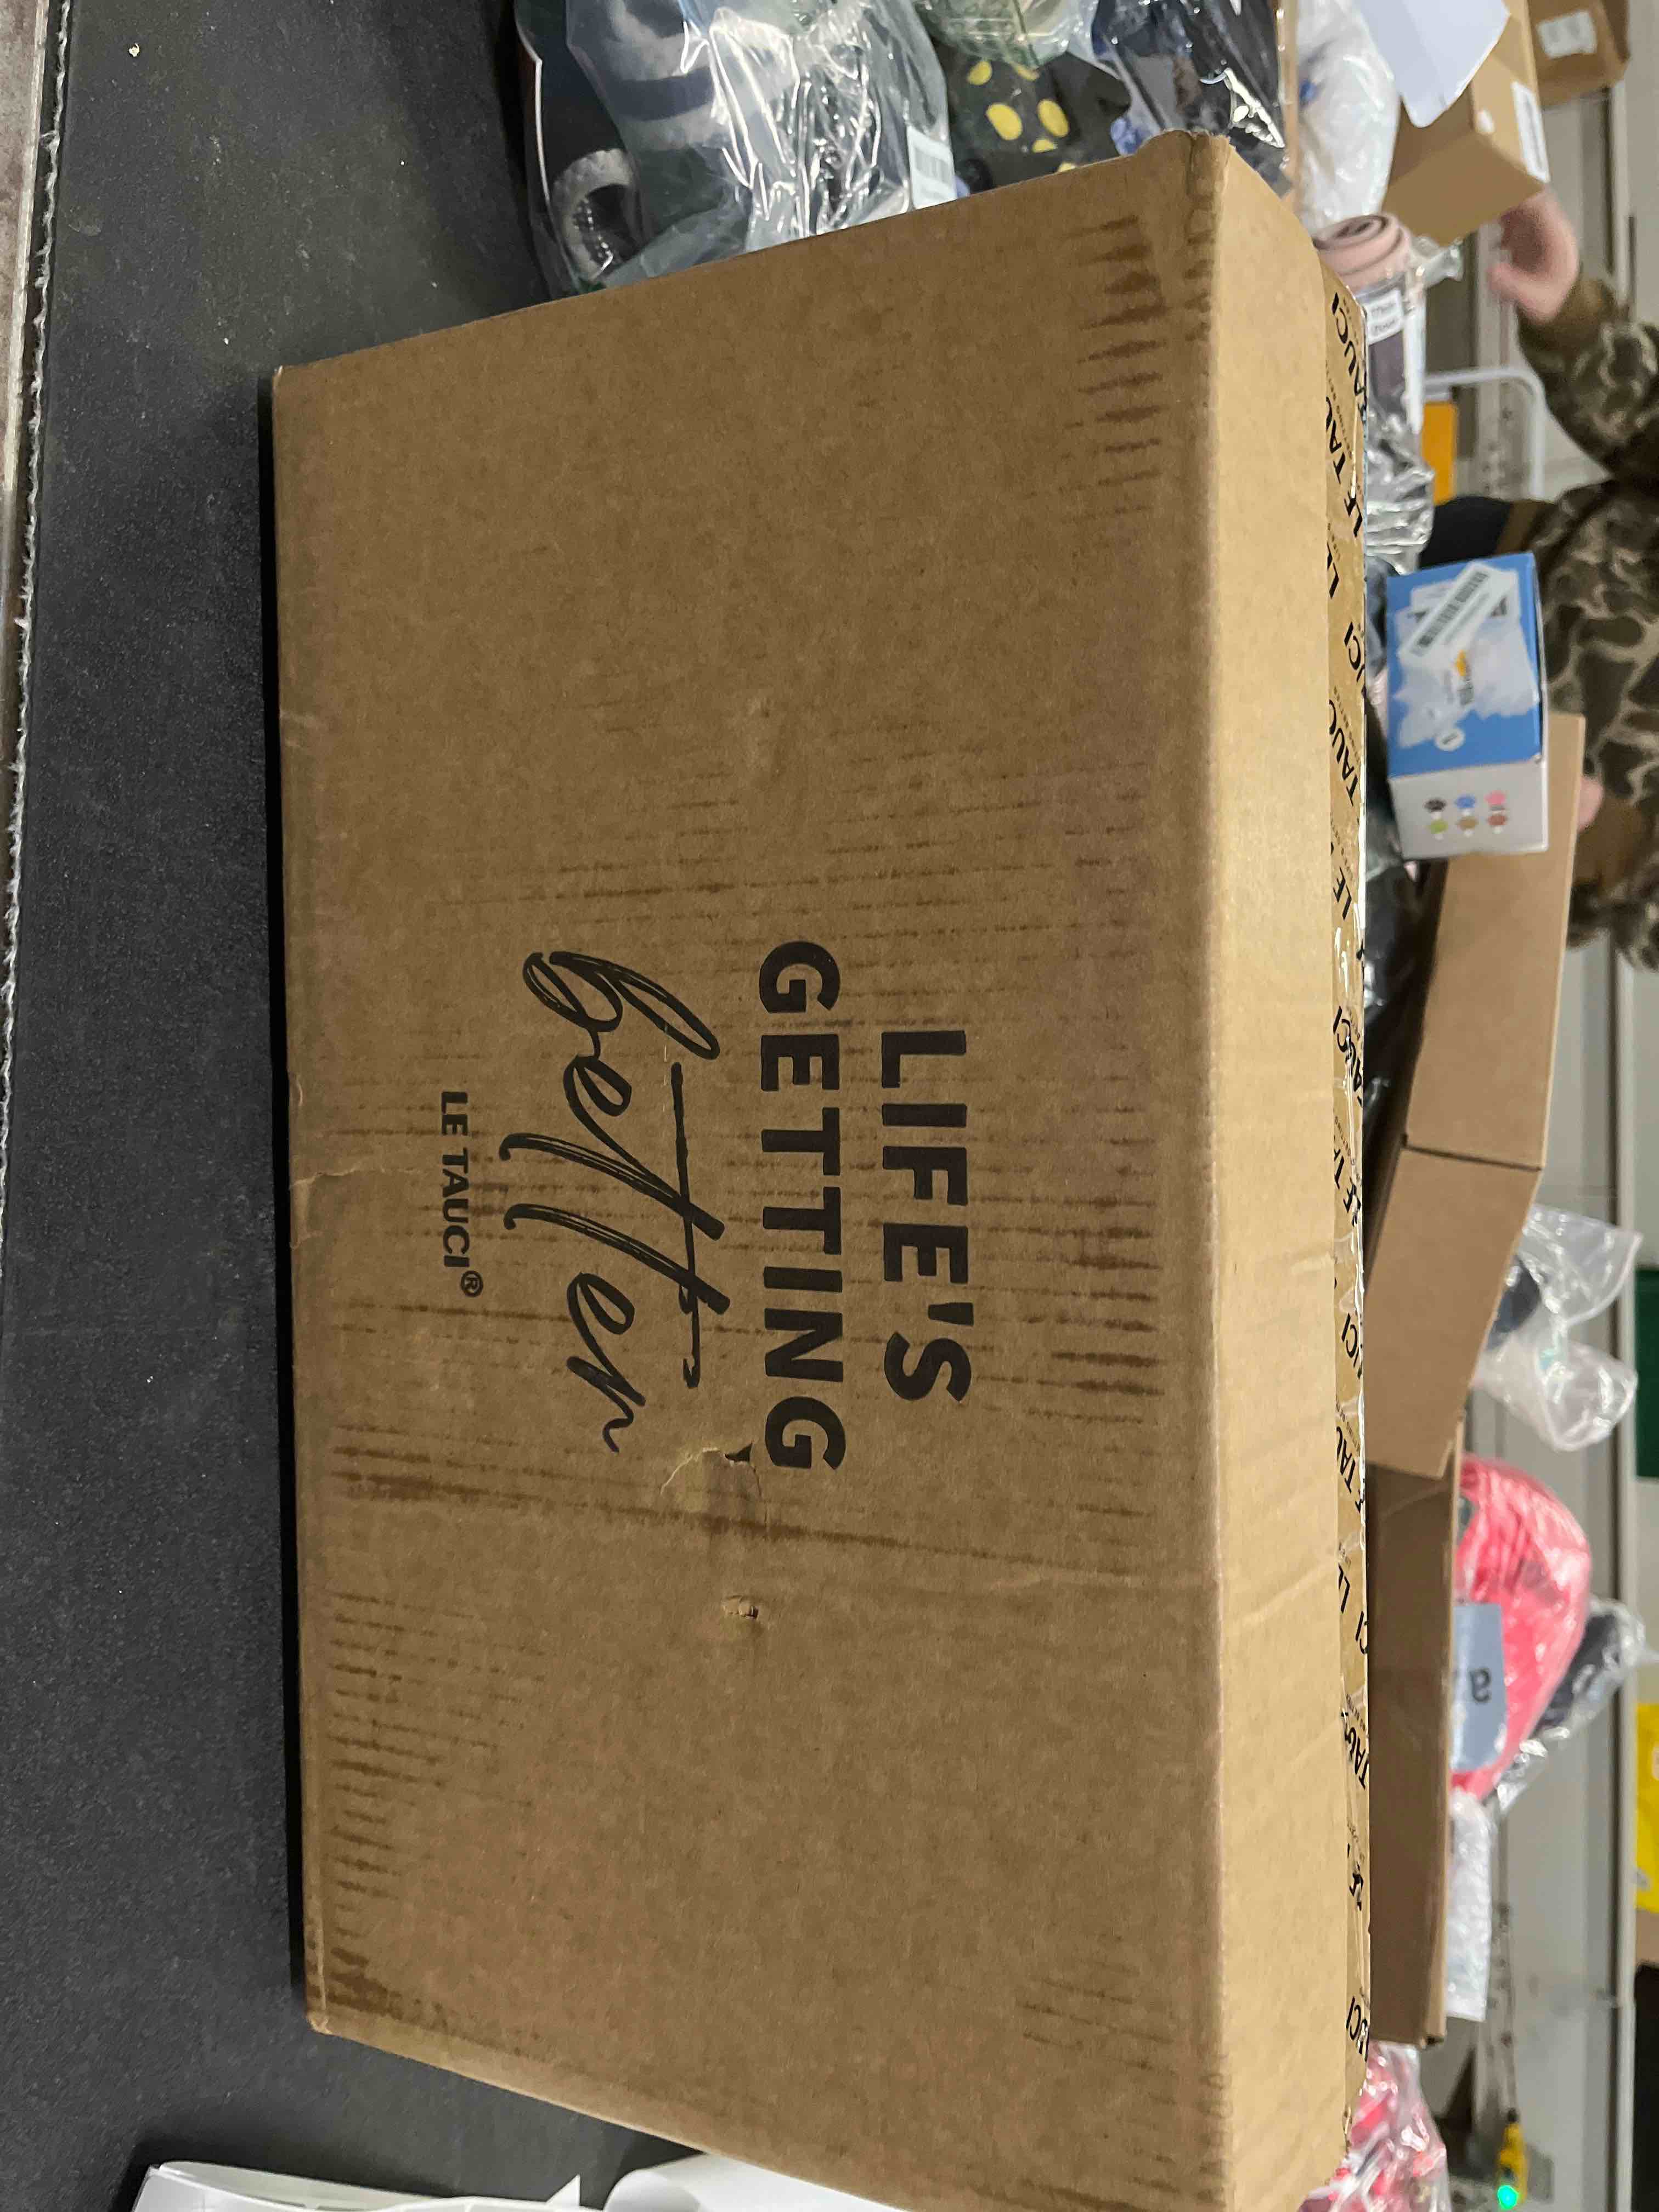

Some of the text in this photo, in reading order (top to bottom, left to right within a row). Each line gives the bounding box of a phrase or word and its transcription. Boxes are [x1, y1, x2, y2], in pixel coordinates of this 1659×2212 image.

[1333, 866, 1352, 921] LE
[440, 1091, 469, 1136] LE
[498, 951, 731, 1453] better
[758, 940, 847, 1470] GETTING
[881, 1030, 974, 1403] LIFE'S
